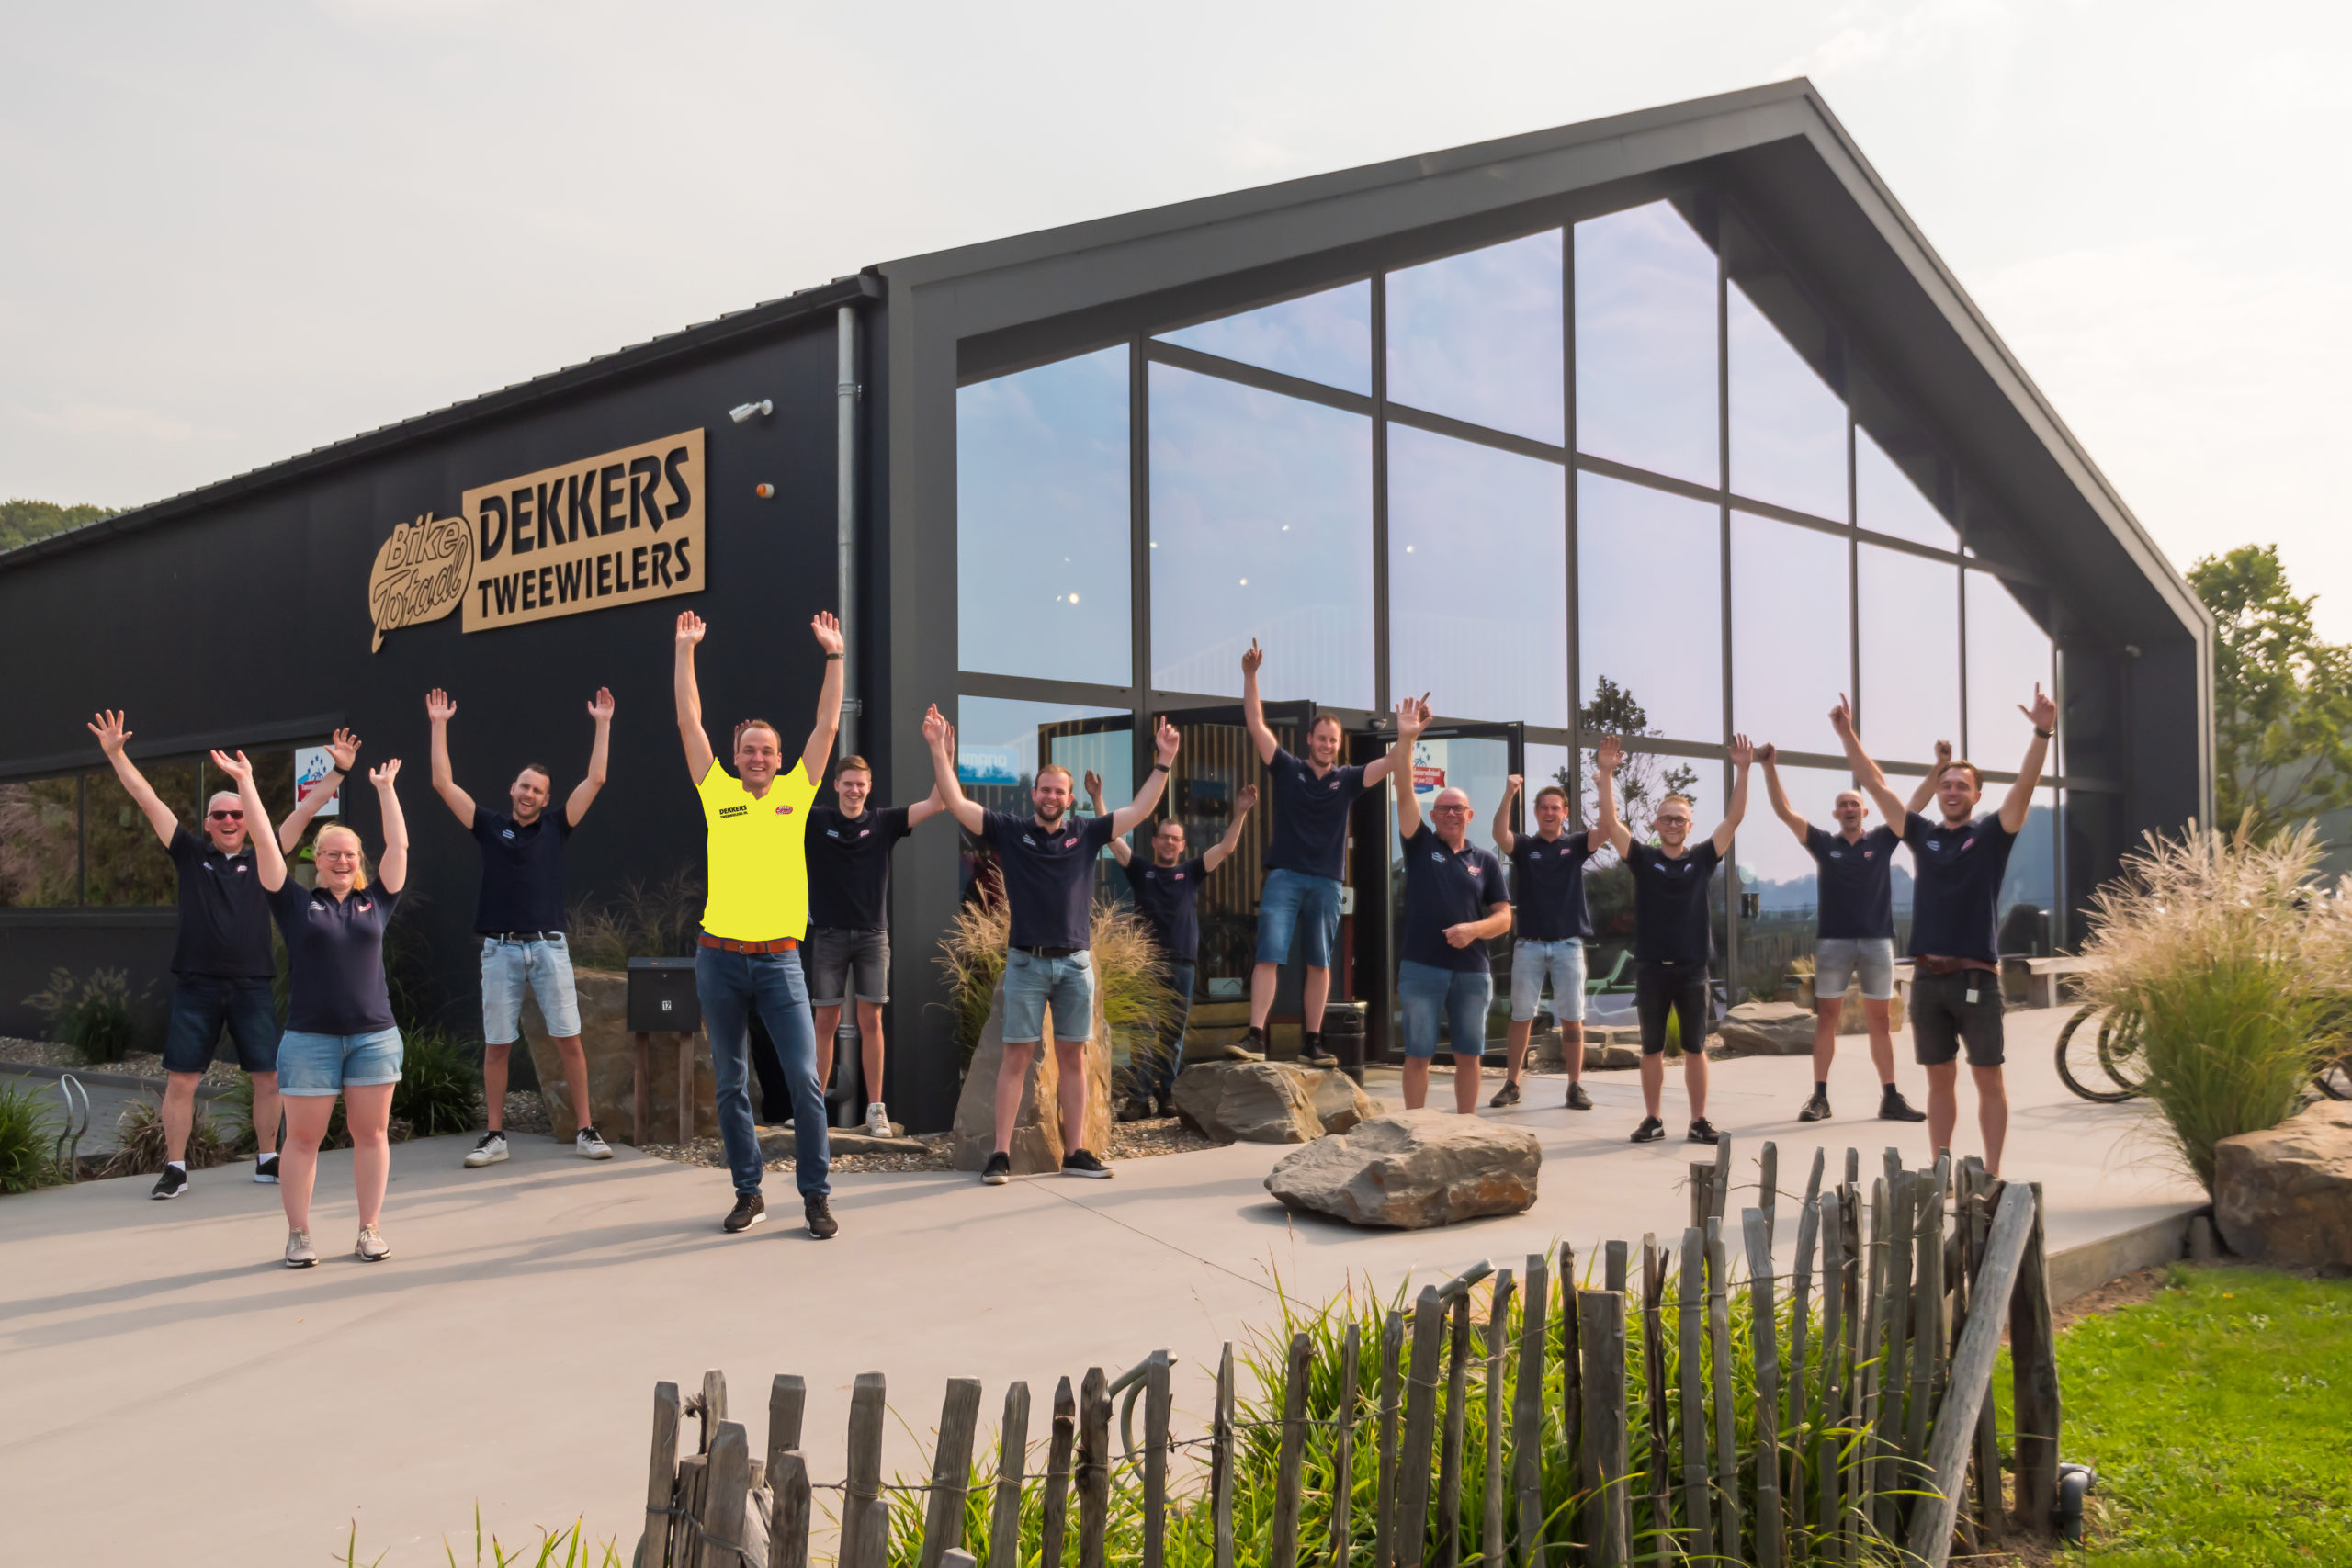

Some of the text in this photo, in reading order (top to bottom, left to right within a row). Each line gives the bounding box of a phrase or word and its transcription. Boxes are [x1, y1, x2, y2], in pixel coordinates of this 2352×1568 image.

[385, 512, 460, 571] Bike
[478, 446, 691, 562] DEKKERS
[371, 534, 469, 653] Totaal
[477, 536, 691, 618] TWEEWIELERS
[719, 805, 747, 815] DEKKERS
